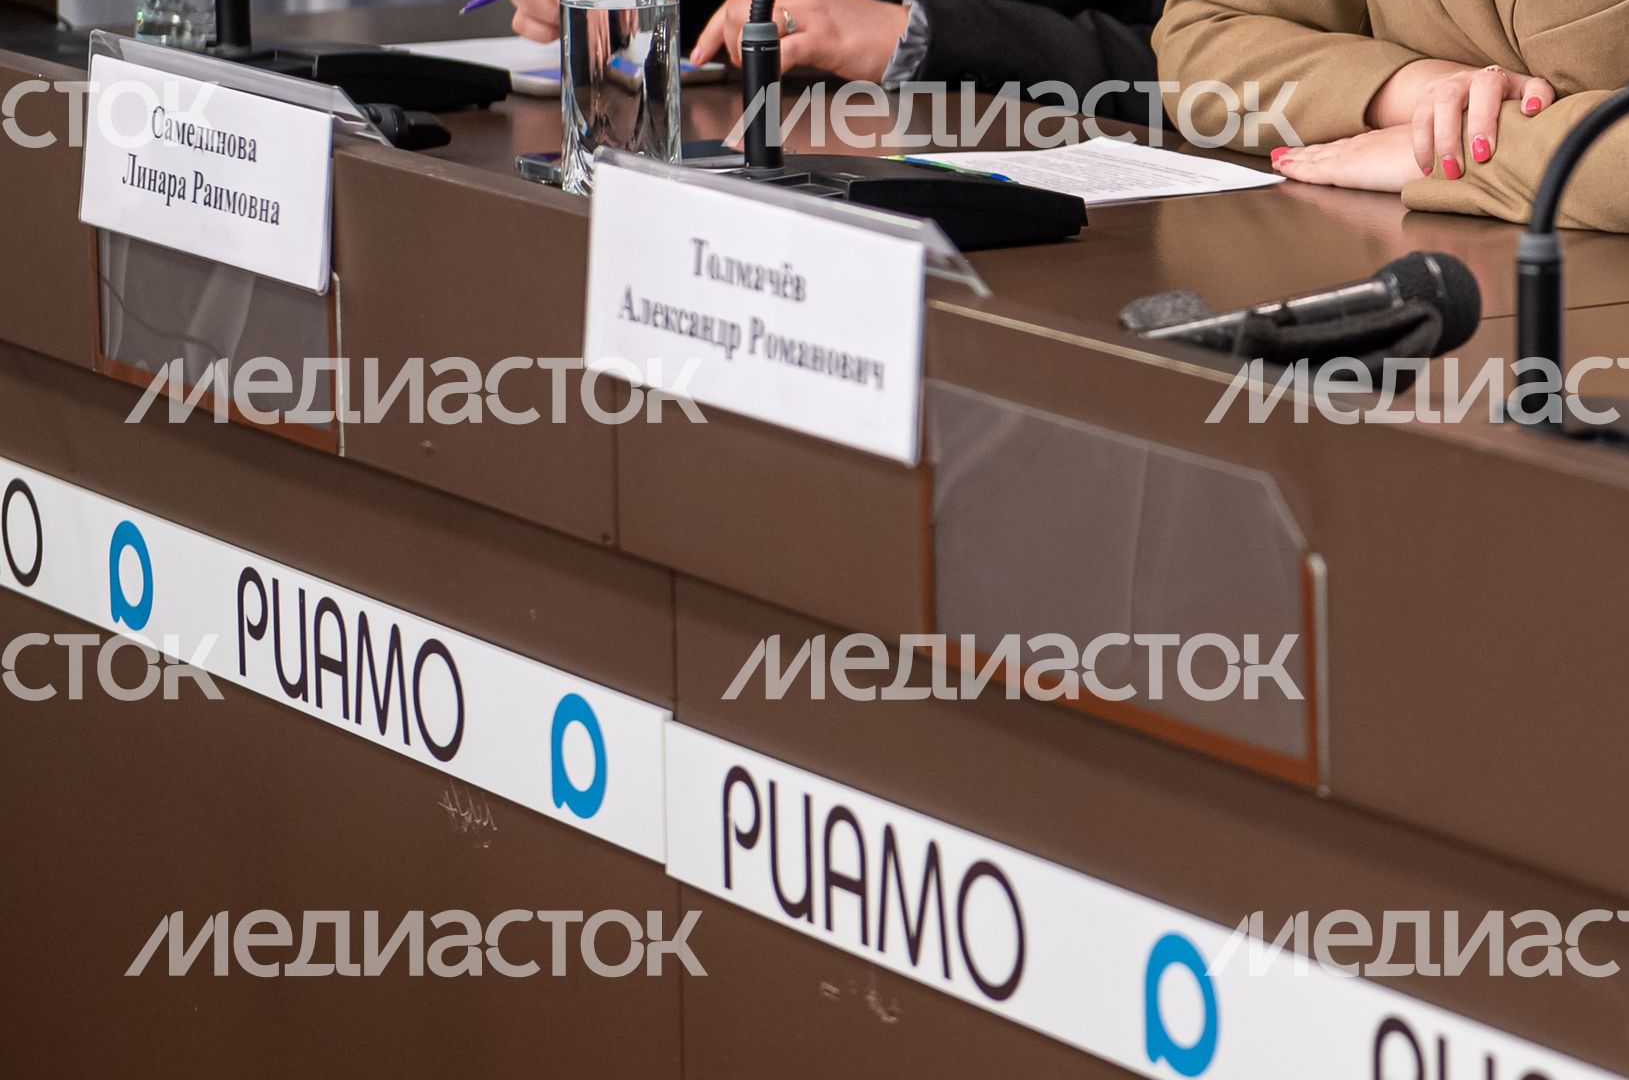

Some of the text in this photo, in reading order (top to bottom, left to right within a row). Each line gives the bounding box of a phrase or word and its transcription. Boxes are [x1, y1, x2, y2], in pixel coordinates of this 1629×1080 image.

[152, 105, 257, 163] Самединова
[122, 152, 281, 226] Линара Раимовна
[690, 237, 807, 302] Толмачёв
[617, 284, 886, 391] Александр Романович
